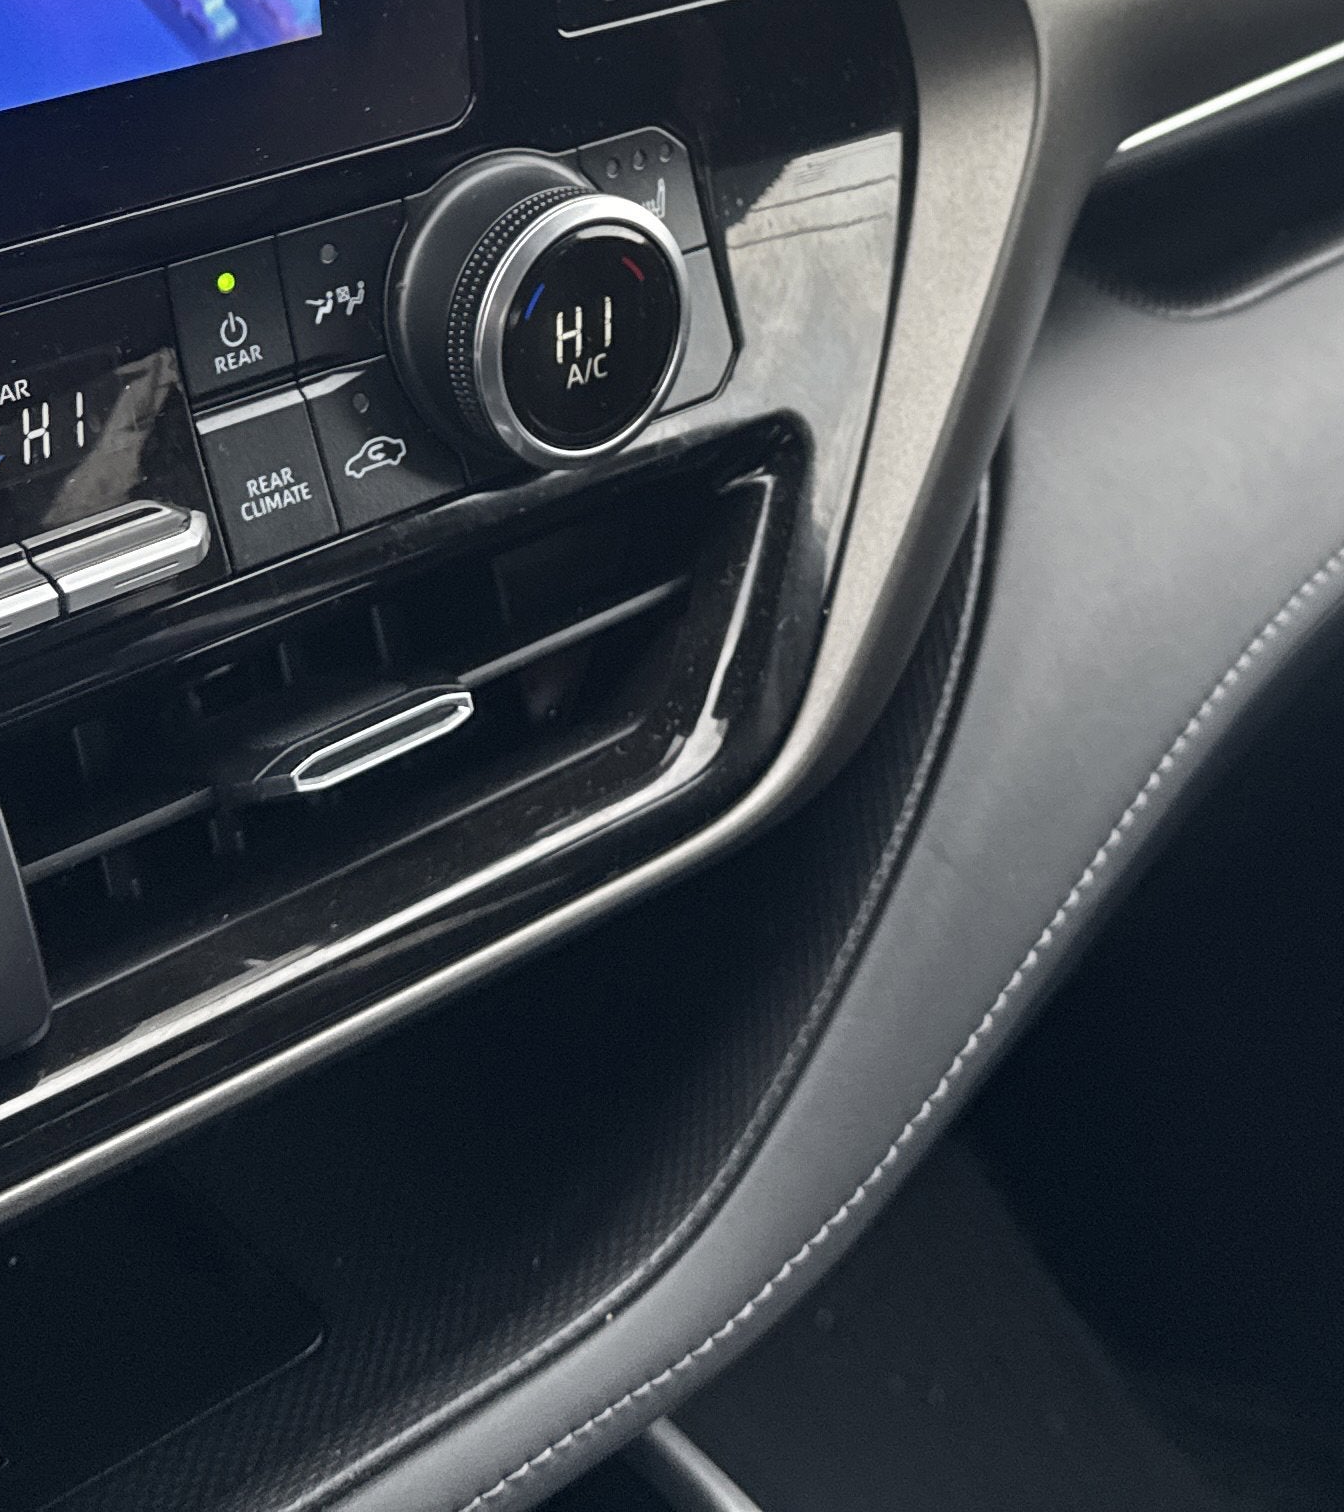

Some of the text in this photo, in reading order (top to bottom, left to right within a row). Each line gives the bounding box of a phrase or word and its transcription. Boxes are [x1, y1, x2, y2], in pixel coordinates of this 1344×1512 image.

[554, 295, 613, 365] HI
[213, 343, 264, 375] REAR
[565, 351, 610, 390] A/C
[21, 391, 85, 466] HI
[245, 465, 296, 497] REAR
[239, 481, 313, 523] CLIMATE
